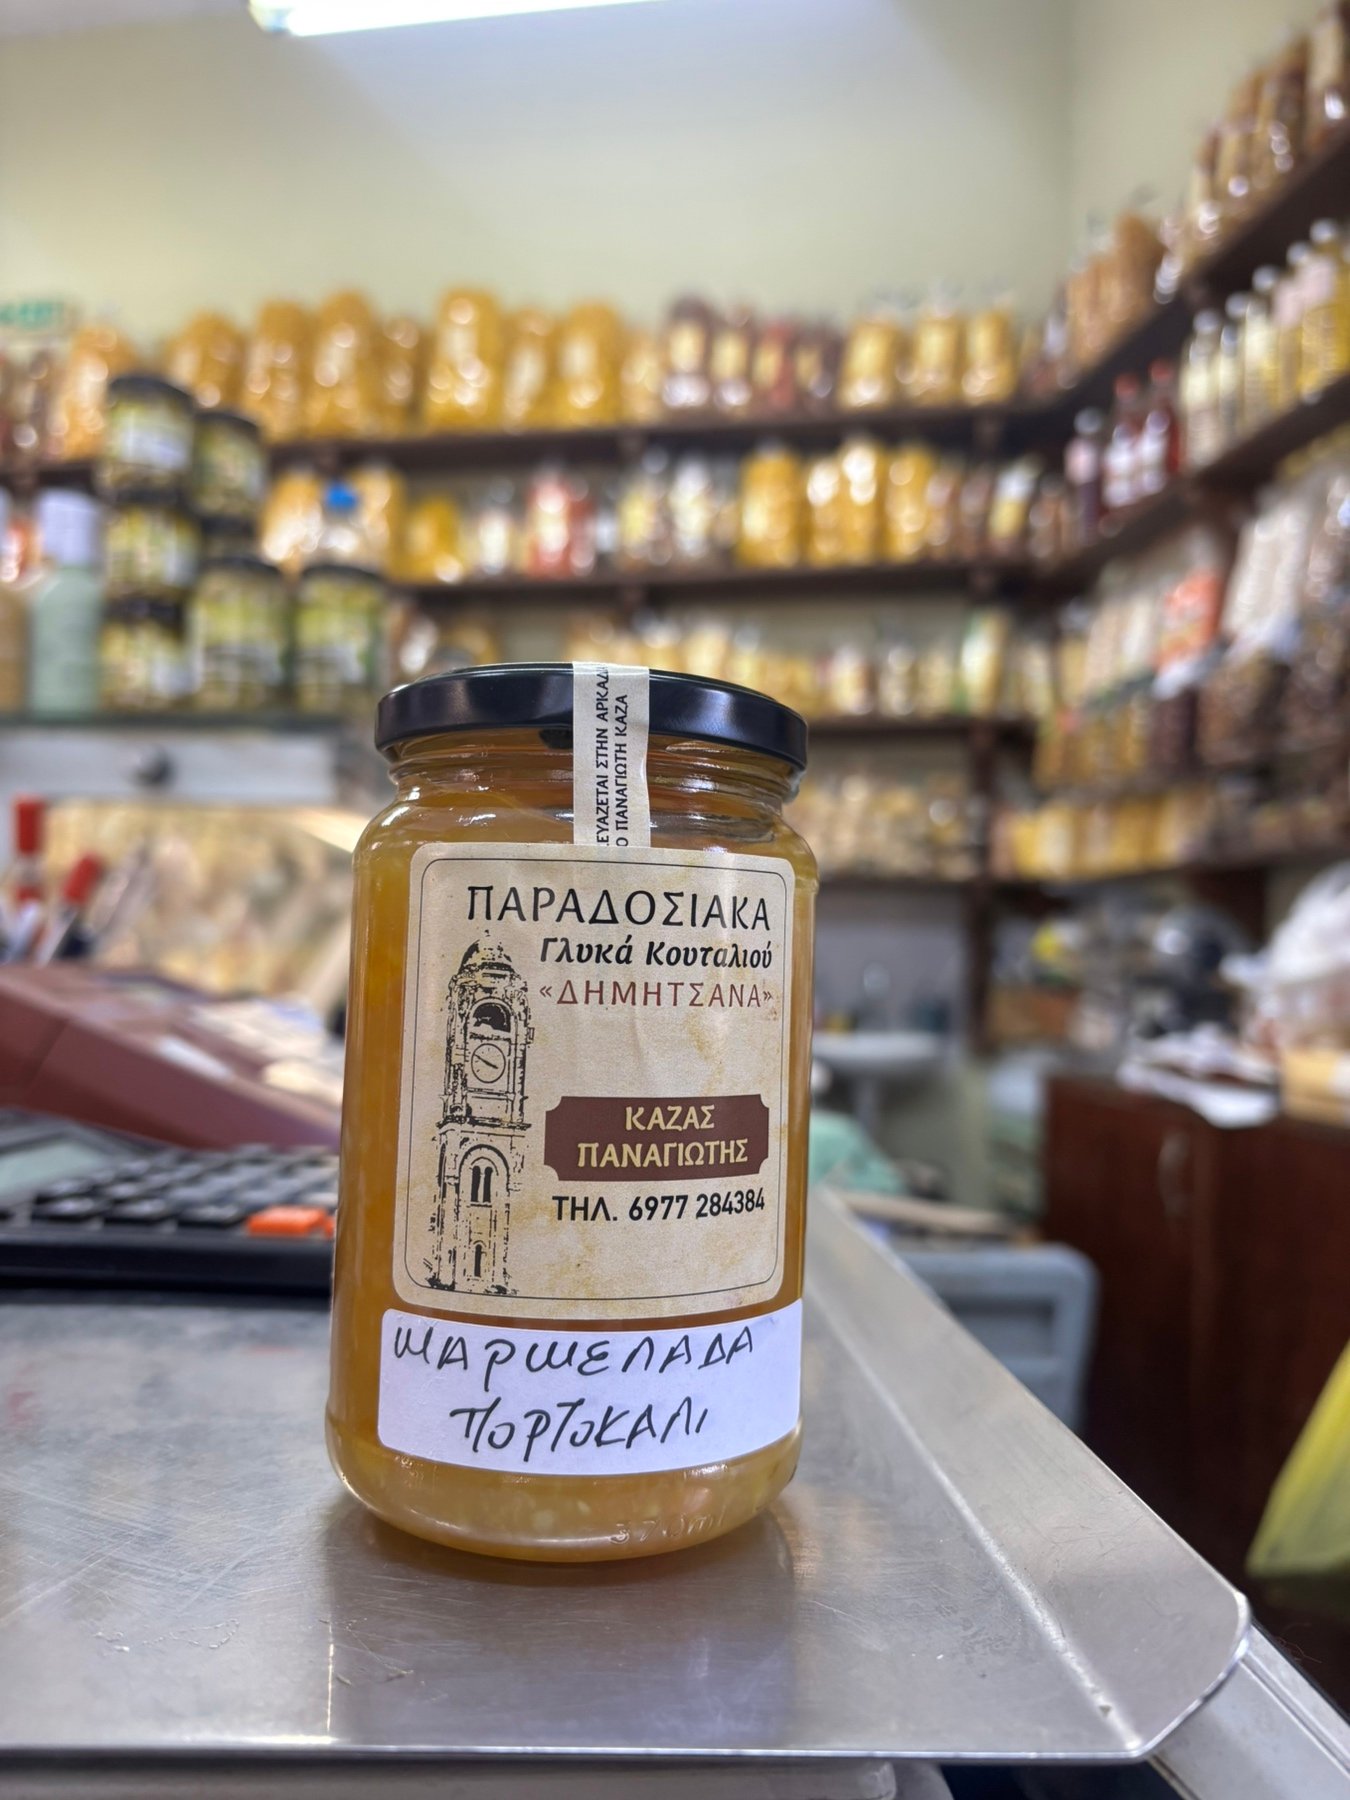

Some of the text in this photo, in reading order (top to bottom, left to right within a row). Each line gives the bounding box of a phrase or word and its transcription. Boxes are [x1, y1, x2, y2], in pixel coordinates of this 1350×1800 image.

[616, 694, 628, 737] ΚΑΖΑ
[596, 728, 609, 768] ΣΤΗΝ
[616, 744, 628, 831] ΠΑΝΑΓΙΩΤΗ
[596, 775, 609, 846] ΕΥΑΖΕΤΑΙ
[467, 885, 771, 931] ΠΑΡΑΔΟΣΙΑΚΑ
[540, 935, 773, 969] Γλυκά Κουταλιού
[539, 980, 773, 1008] «ΔΗΜΗΤΣΑΝΑ»
[624, 1104, 716, 1131] ΚΑΖΑΣ
[576, 1138, 749, 1168] ΠΑΝΑΓΙΩΤΗΣ
[551, 1187, 765, 1222] ΤΗΛ. 6977 284384
[449, 1396, 709, 1462] ΠΟΡΤΟΚΑΛΙ
